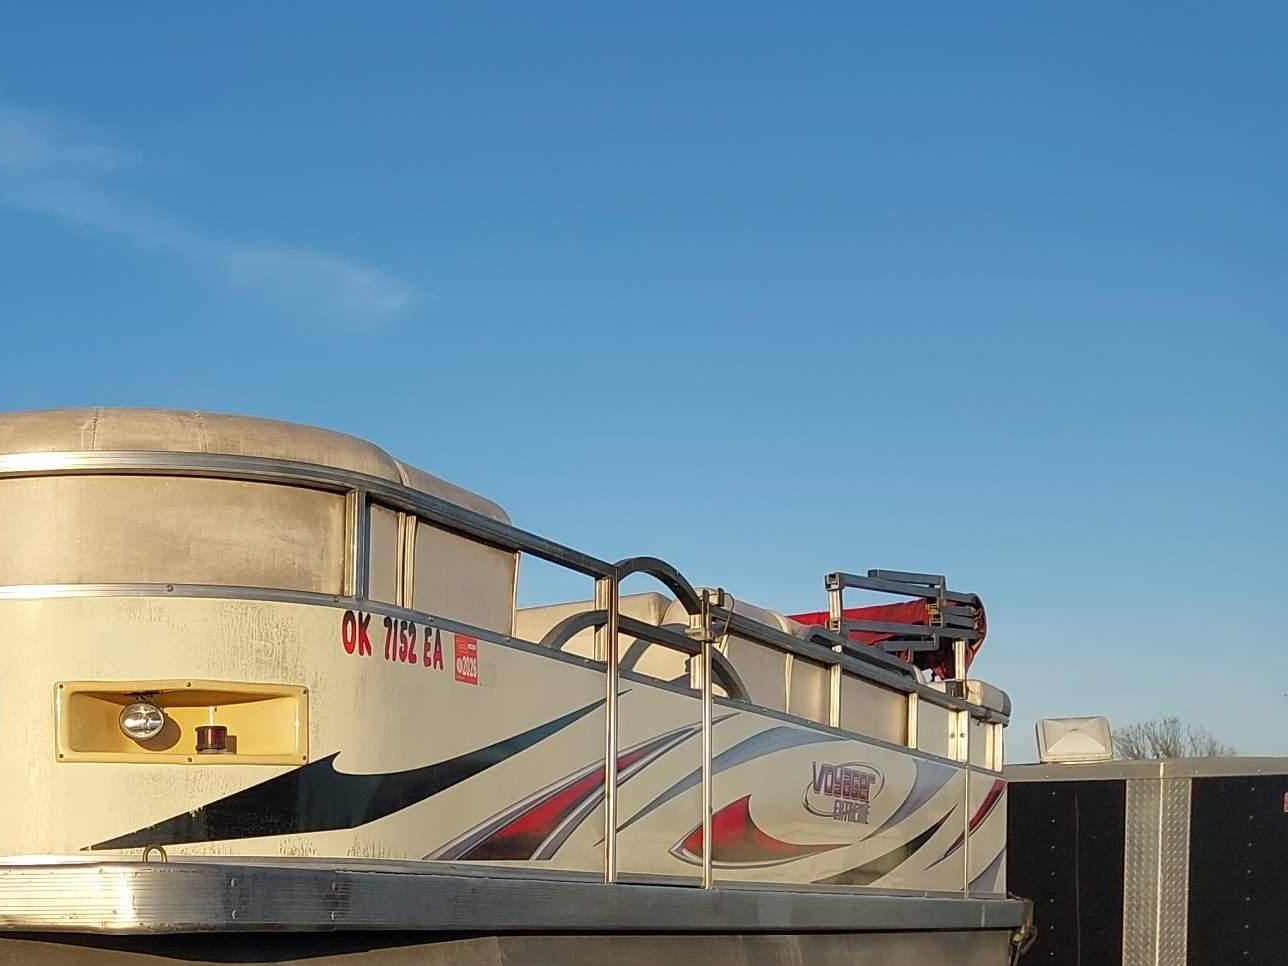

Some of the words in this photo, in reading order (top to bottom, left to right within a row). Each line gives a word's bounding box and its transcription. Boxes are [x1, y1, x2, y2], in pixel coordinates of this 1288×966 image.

[342, 610, 372, 656] OK
[383, 616, 417, 664] 7152
[423, 627, 443, 670] EA
